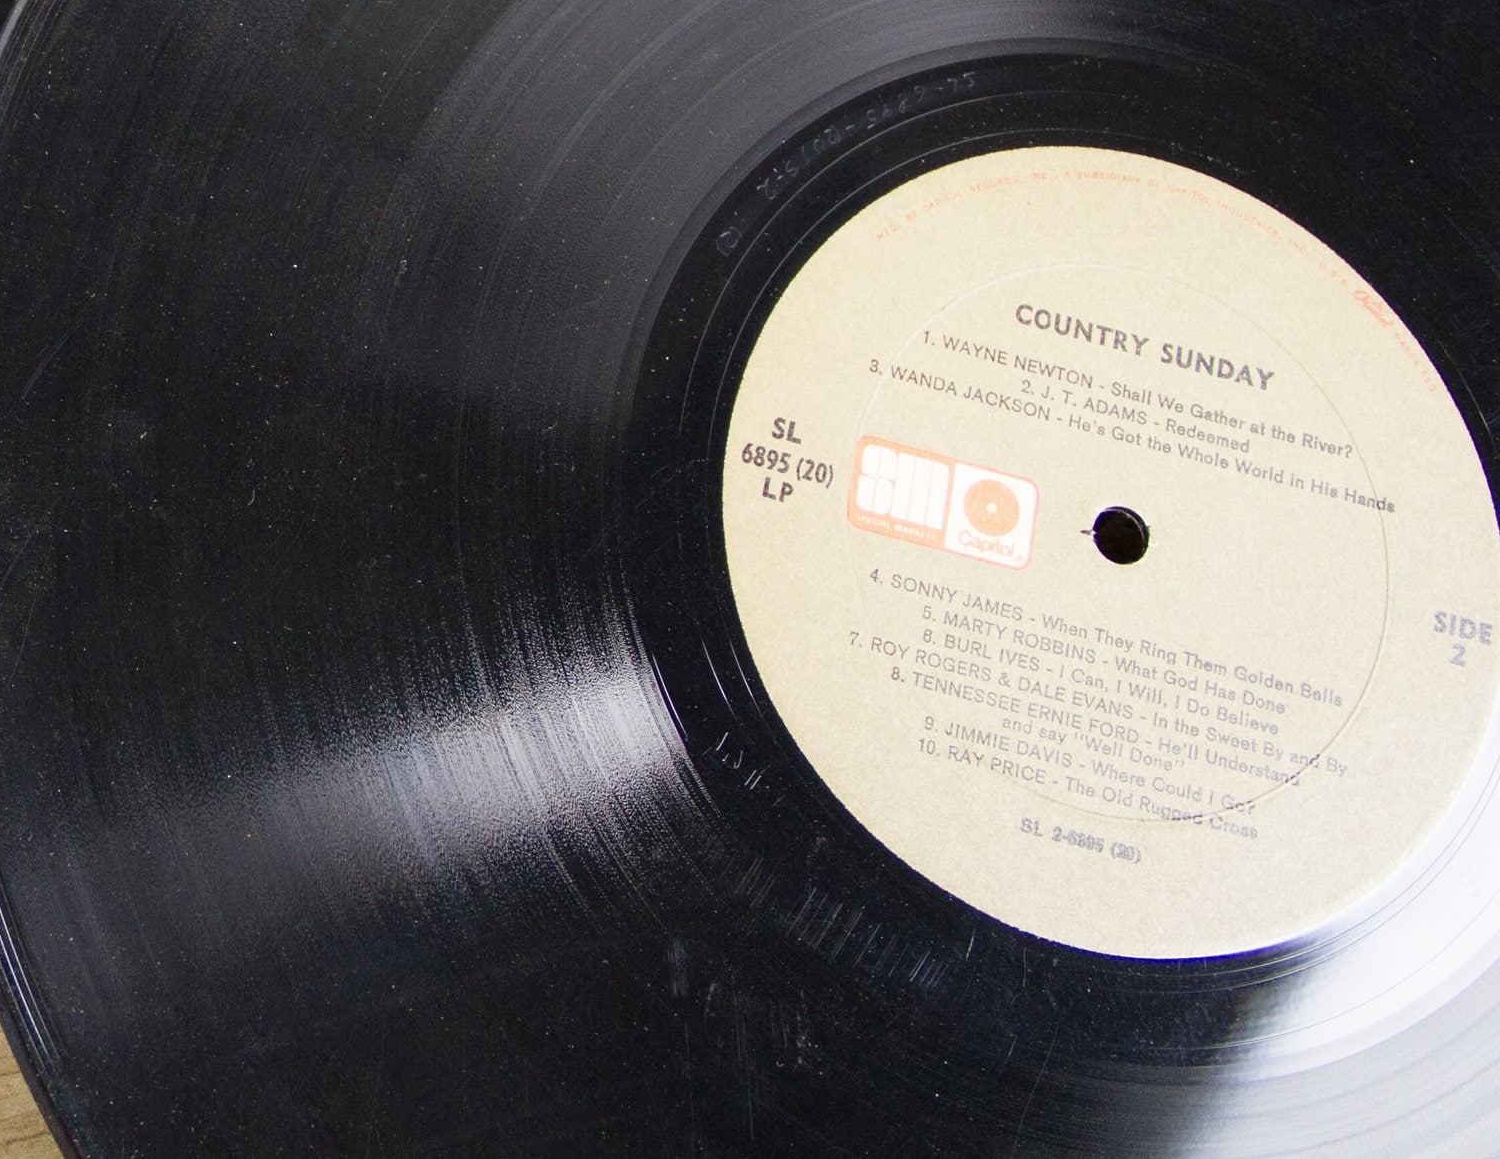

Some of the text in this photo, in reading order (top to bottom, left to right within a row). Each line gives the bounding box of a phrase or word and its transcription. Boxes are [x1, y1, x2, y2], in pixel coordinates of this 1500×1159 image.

[1015, 304, 1274, 390] COUNTRY SUNDAY
[923, 330, 935, 345] 1.
[943, 334, 1008, 366] WAYNE
[1013, 355, 1093, 389] NEWTON
[1110, 381, 1151, 405] Shall
[1157, 393, 1184, 413] We
[1190, 403, 1245, 429] Gather
[1249, 422, 1264, 436] at
[1270, 425, 1296, 444] the
[1301, 432, 1352, 458] River?
[1021, 379, 1034, 395] 2.
[1040, 385, 1054, 401] J.
[1061, 389, 1076, 407] T.
[1082, 397, 1147, 425] ADAMS
[1165, 417, 1250, 453] Redeemed
[771, 417, 801, 444] SL
[869, 358, 882, 375] 3.
[890, 365, 957, 396] WANDA
[962, 385, 1050, 421] JACKSON
[1068, 414, 1105, 436] He's
[1111, 425, 1142, 446] Got
[1147, 435, 1172, 454] the
[1177, 442, 1229, 469] Whole
[1234, 458, 1284, 484] World
[1289, 472, 1304, 490] in
[1310, 478, 1338, 498] His
[1344, 487, 1395, 513] Hands
[741, 442, 833, 489] 6895 (20)
[761, 476, 794, 502] LP
[959, 530, 1015, 558] Capitol
[869, 568, 882, 584] 4.
[890, 573, 958, 603] SONNY
[962, 593, 1022, 621] JAMES
[1042, 613, 1087, 639] When
[1094, 627, 1134, 653] They
[1139, 639, 1177, 665] Ring
[1182, 651, 1227, 676] Them
[1234, 665, 1293, 693] Golden
[1300, 682, 1342, 707] Bells
[1433, 610, 1493, 645] SIDE
[1448, 643, 1466, 667] 2
[922, 605, 936, 622] 5.
[943, 610, 1007, 639] MARTY
[1012, 629, 1096, 664] ROBBINS
[1115, 655, 1158, 680] What
[1163, 669, 1198, 691] God
[1204, 679, 1236, 701] Has
[1242, 689, 1285, 714] Done
